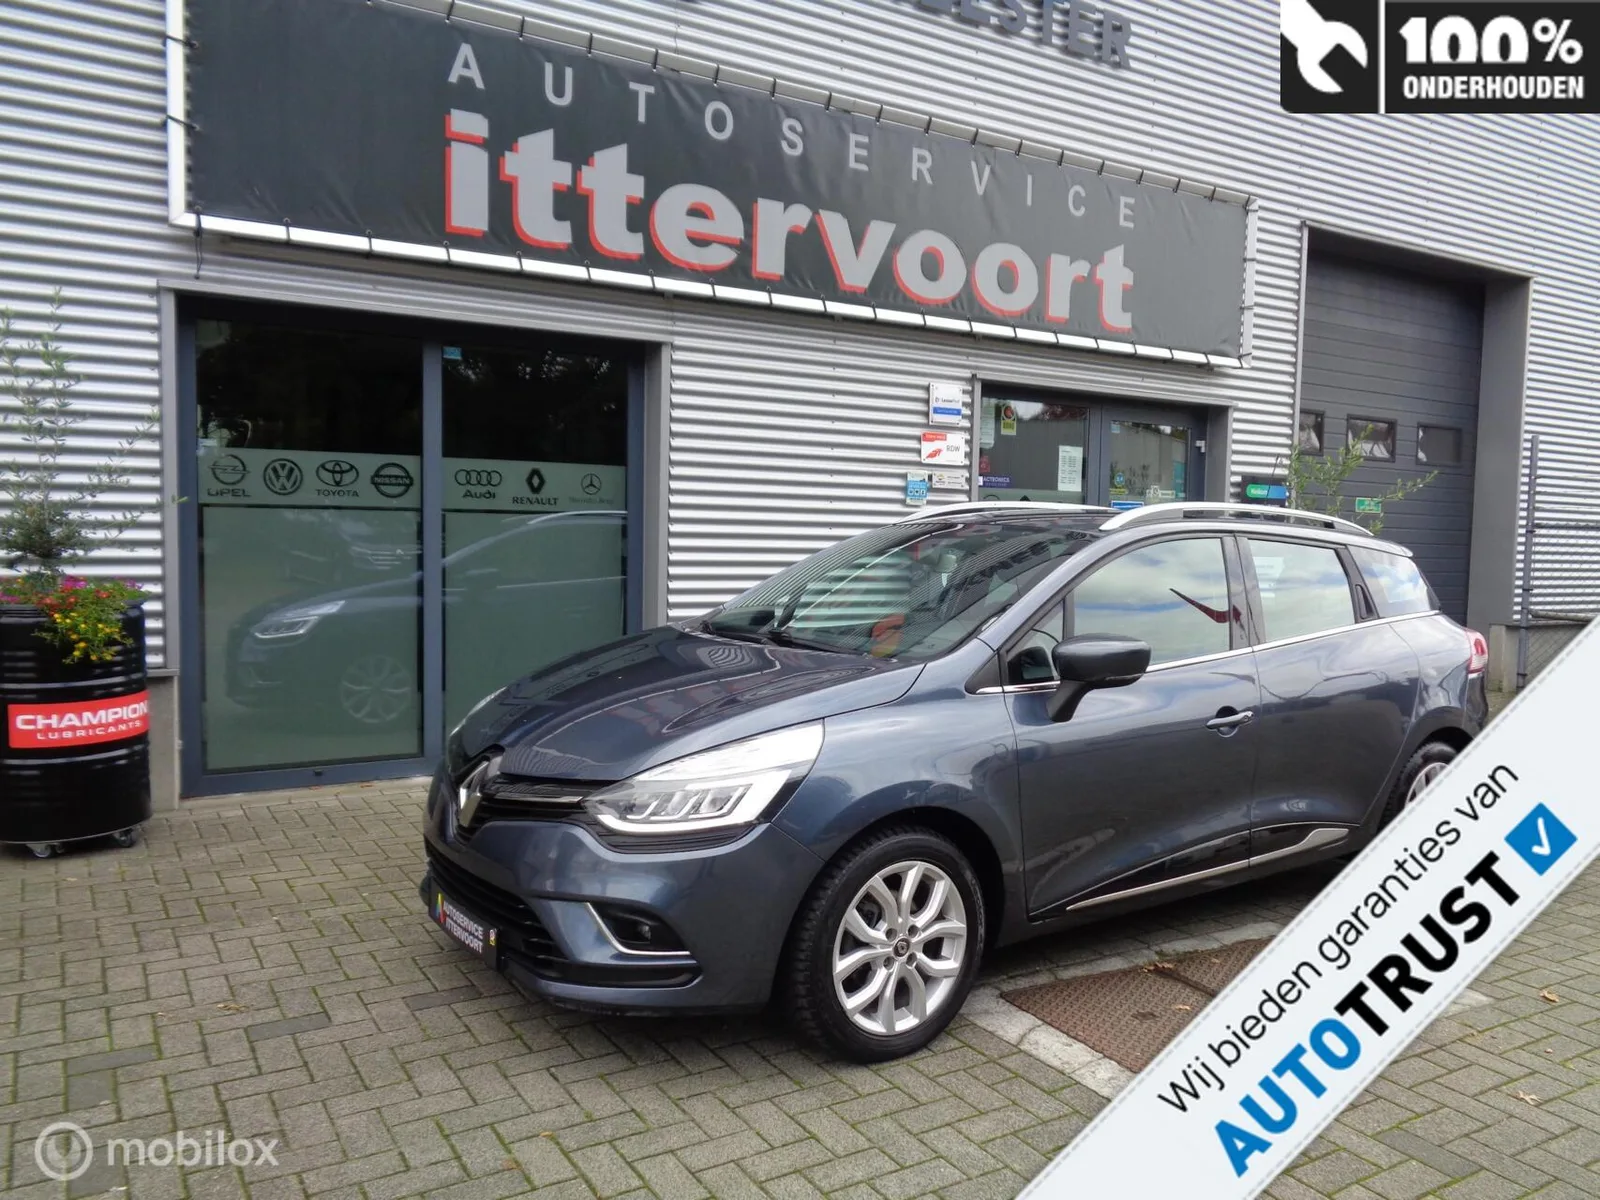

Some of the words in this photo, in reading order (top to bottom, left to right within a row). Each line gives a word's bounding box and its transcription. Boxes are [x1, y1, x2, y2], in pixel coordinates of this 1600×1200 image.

[916, 0, 1132, 69] STER
[447, 42, 1136, 229] AUTOSERVICE
[444, 108, 1135, 332] ittervoort
[946, 444, 961, 452] RDW
[315, 489, 360, 498] TOYOTA
[462, 489, 496, 499] Audi
[512, 496, 559, 506] RENAULT
[15, 700, 149, 730] CHAMPION
[36, 720, 142, 740] LUBRICANTS
